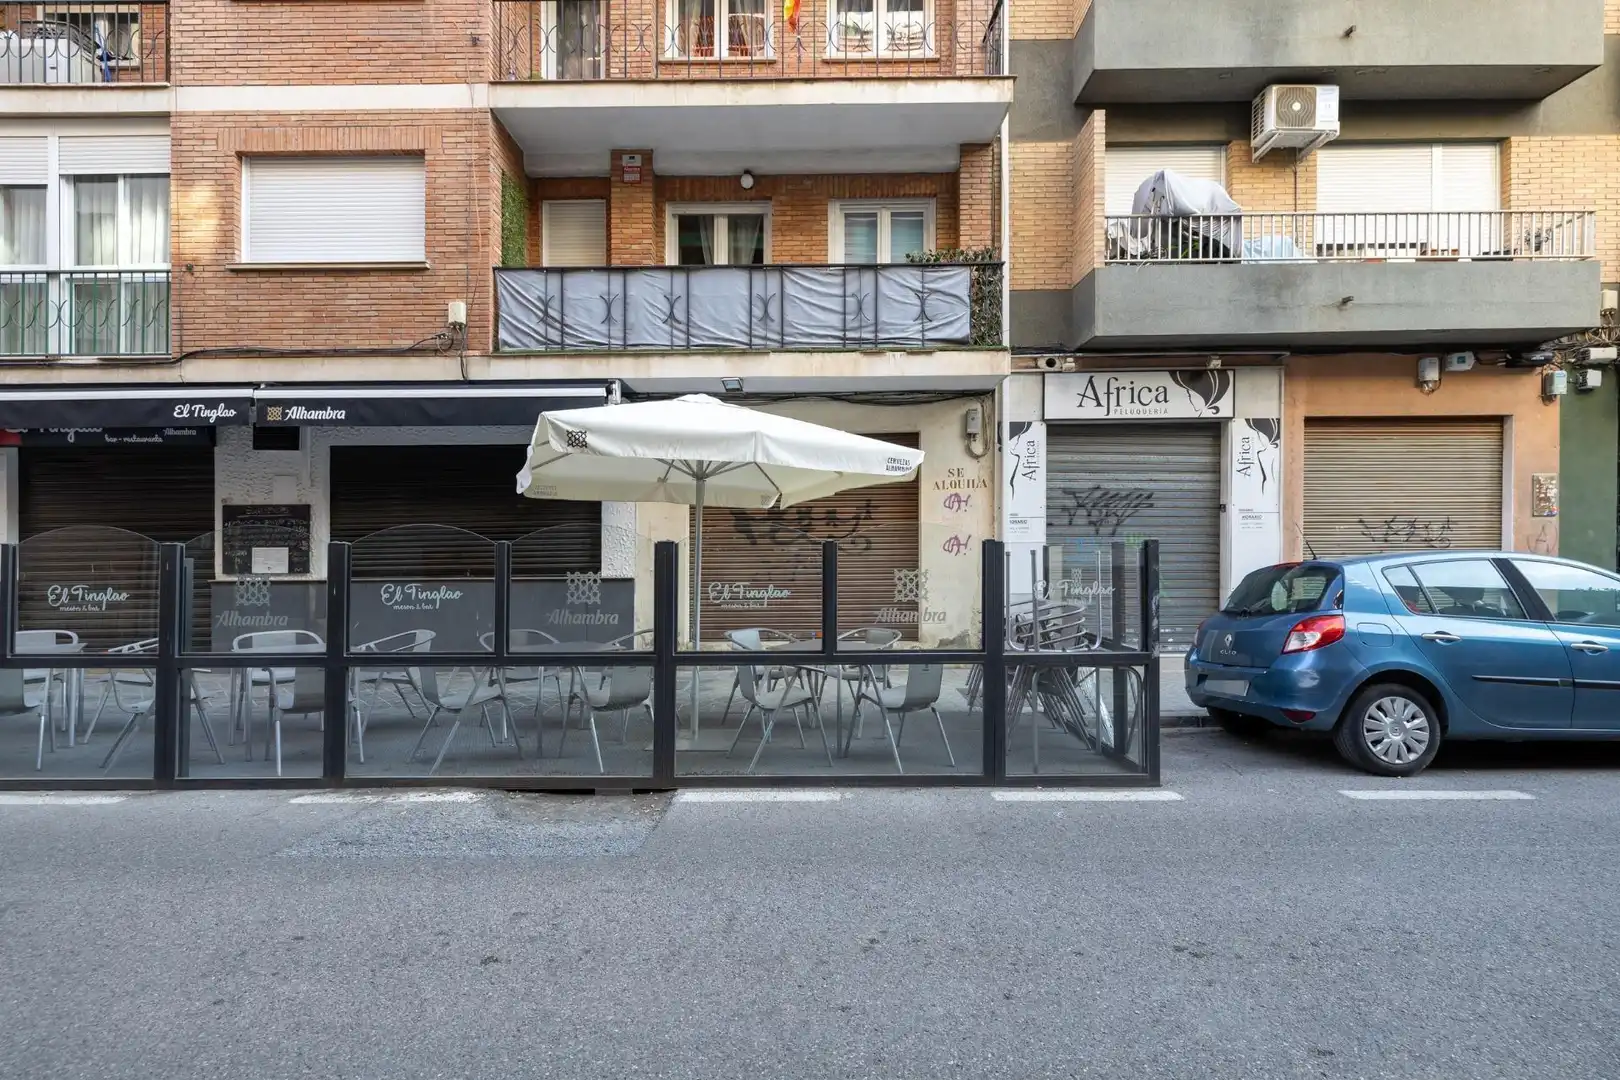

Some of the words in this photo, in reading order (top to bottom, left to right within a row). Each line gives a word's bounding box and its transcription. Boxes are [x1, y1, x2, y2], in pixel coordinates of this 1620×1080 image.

[1076, 375, 1170, 416] Africa
[173, 404, 190, 418] El
[191, 402, 237, 423] Tinglao
[284, 406, 346, 421] Alhambra
[1021, 440, 1040, 481] Africa
[1235, 437, 1255, 477] Africa
[947, 467, 965, 478] SE
[933, 479, 988, 490] ALQUILA
[47, 584, 70, 607] El
[70, 584, 130, 611] Tinglao
[380, 583, 403, 605] El
[404, 583, 464, 609] Tinglao
[708, 581, 732, 604] El
[731, 581, 792, 608] Tinglao
[215, 610, 289, 629] Alhambra
[546, 609, 619, 626] Alhambra
[873, 607, 947, 623] Alhambra
